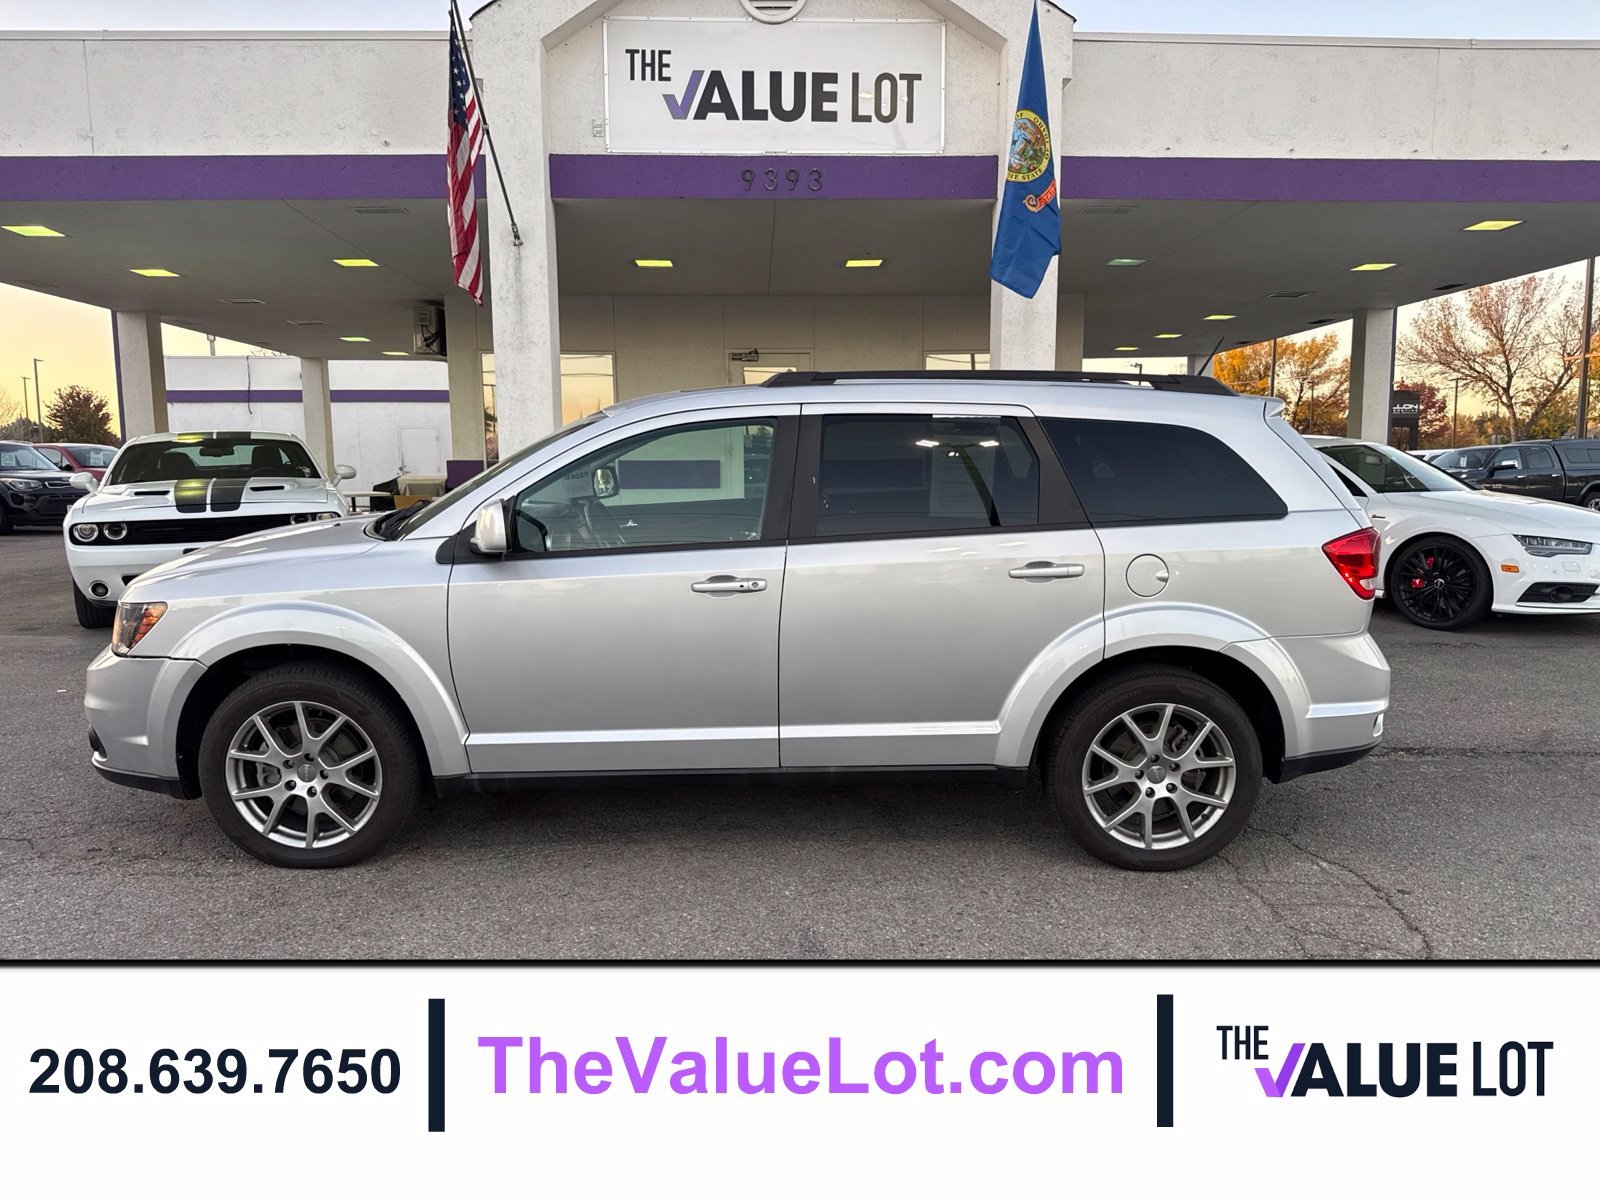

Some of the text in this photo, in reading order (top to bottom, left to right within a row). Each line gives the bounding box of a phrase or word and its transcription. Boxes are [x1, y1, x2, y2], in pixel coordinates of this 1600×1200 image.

[625, 48, 672, 82] THE
[662, 70, 922, 124] VALUE LOT
[740, 168, 824, 192] 9393
